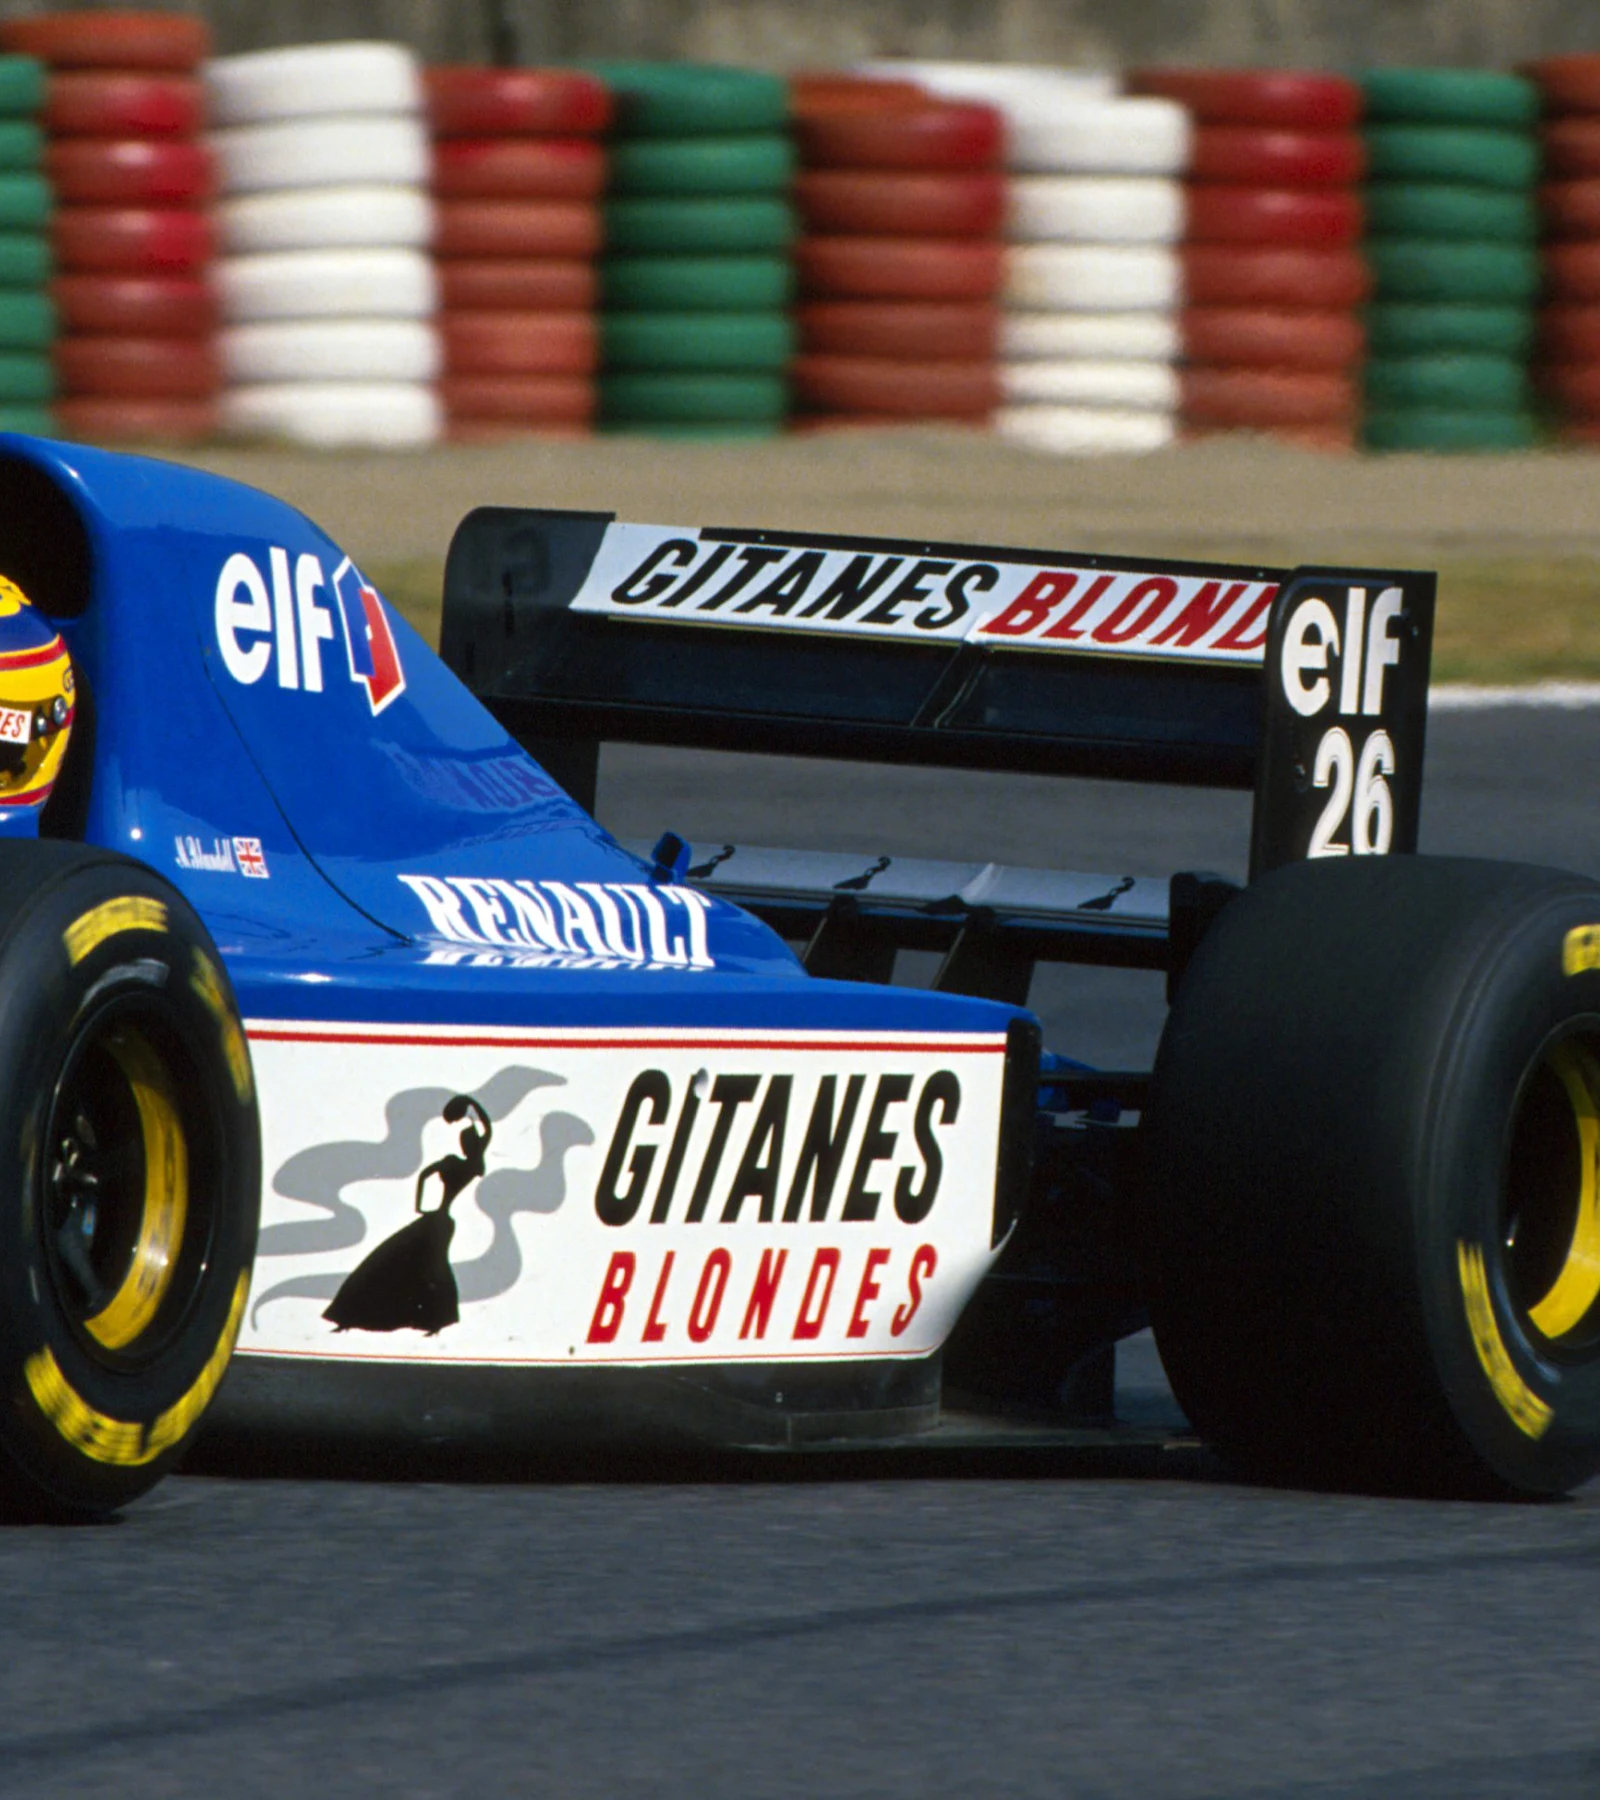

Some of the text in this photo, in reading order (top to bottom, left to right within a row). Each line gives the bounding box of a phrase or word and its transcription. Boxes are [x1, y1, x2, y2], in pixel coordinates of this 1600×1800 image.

[215, 546, 333, 692] elf
[611, 538, 1000, 630] GITANES
[1281, 587, 1405, 717] elf
[1307, 726, 1396, 859] 26
[398, 874, 716, 968] RENAULT
[595, 1069, 961, 1228] GITANES
[586, 1244, 936, 1343] BLONDES
